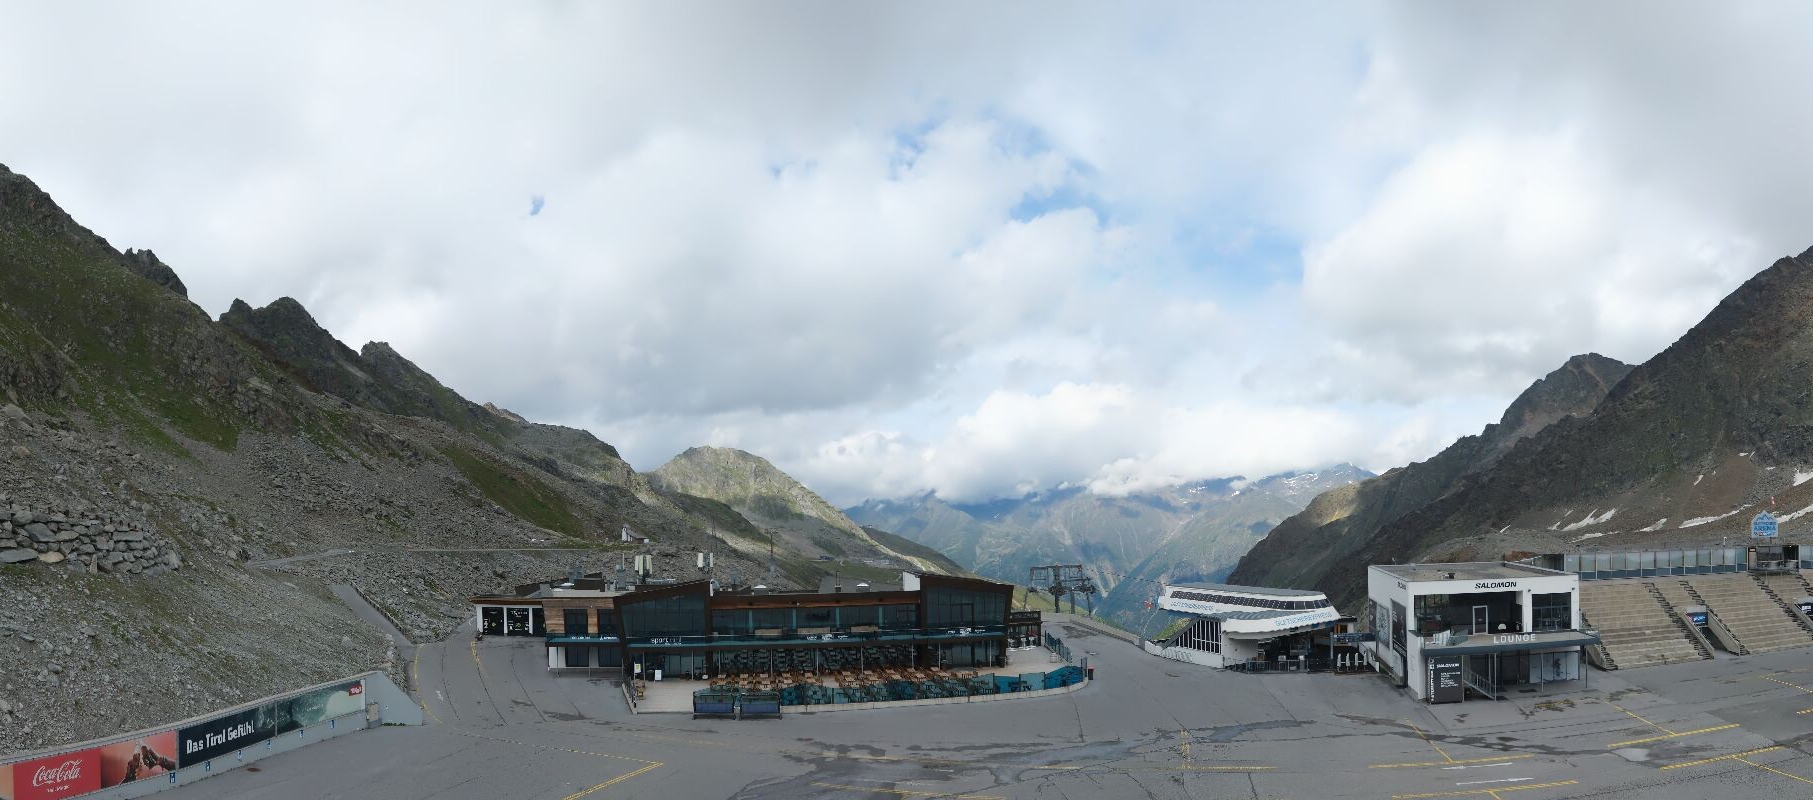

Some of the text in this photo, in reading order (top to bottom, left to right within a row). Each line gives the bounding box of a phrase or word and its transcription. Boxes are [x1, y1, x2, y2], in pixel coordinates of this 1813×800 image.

[1474, 581, 1517, 589] SALOMON
[650, 637, 668, 645] sport
[1493, 633, 1536, 644] LOUNGE
[186, 720, 255, 755] Das Tirol Gefühl
[32, 759, 83, 787] Coca-Cola
